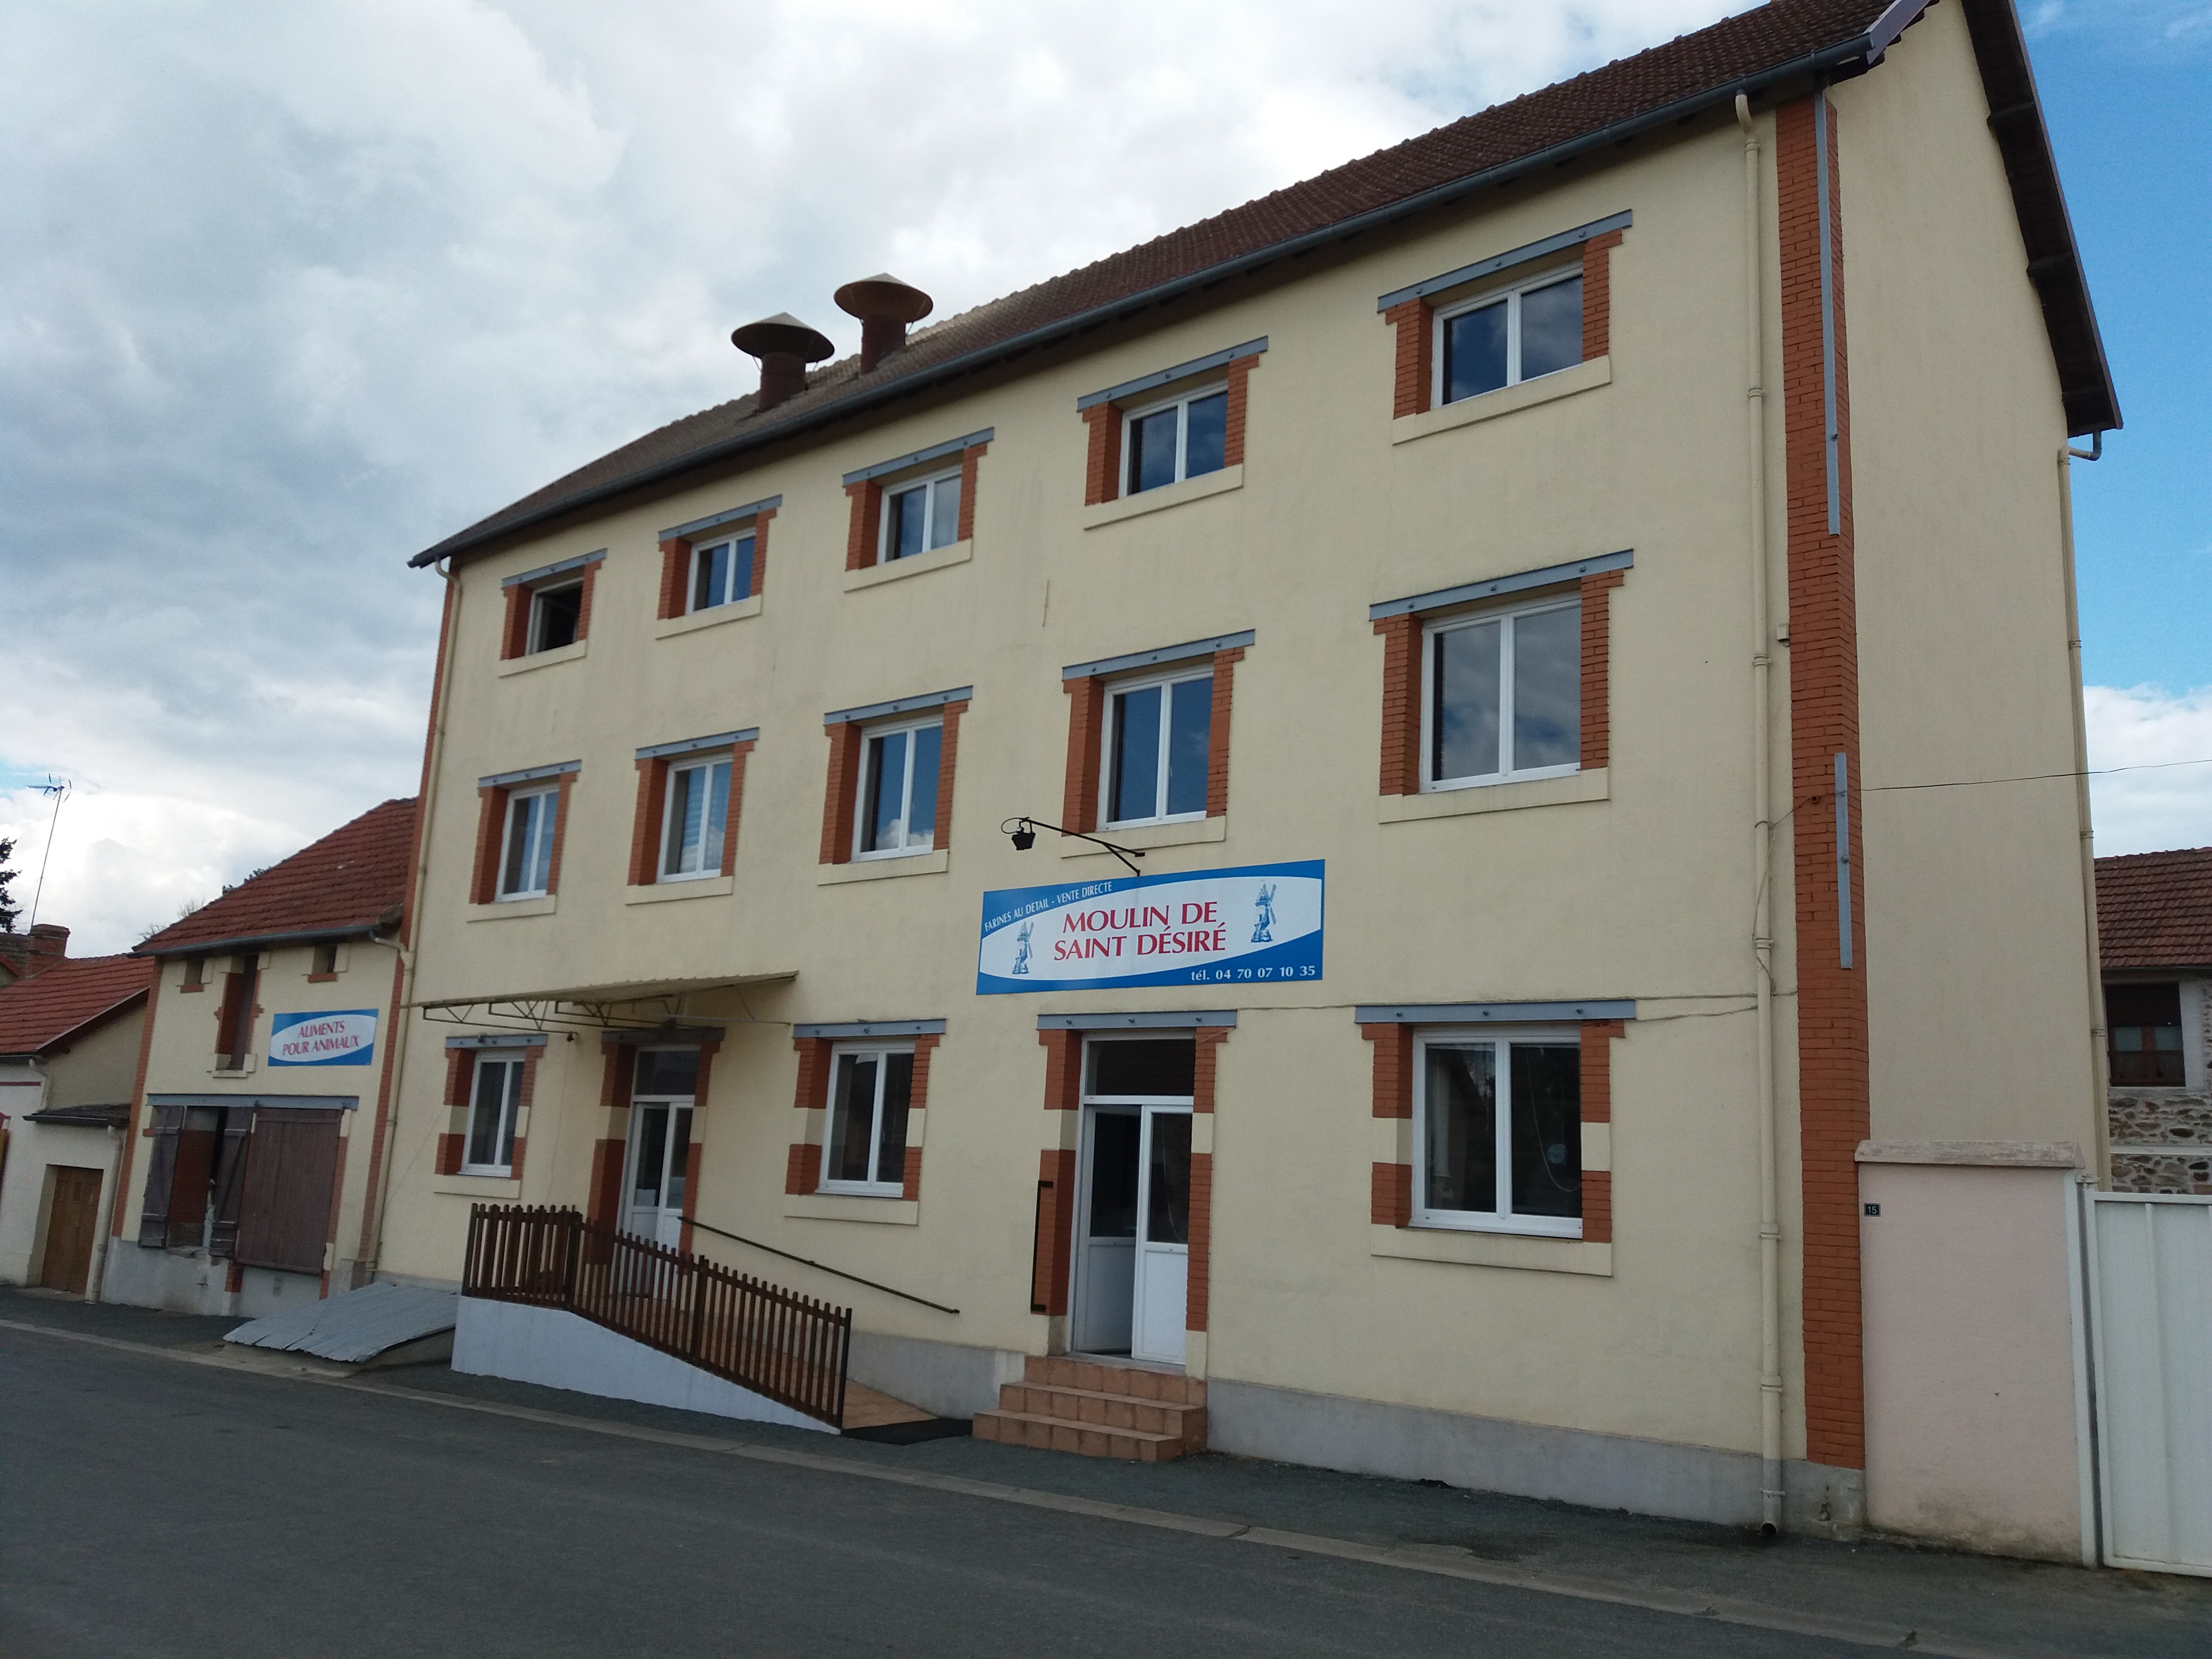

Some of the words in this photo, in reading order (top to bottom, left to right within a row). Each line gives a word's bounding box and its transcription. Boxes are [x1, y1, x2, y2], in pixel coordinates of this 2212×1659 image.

[984, 911, 1012, 932] FARINES
[1013, 907, 1023, 918] AU
[1026, 898, 1049, 915] DETAIL
[1057, 890, 1079, 904] VENTE
[1082, 881, 1112, 897] DIRECTE
[1063, 905, 1169, 933] MOULIN
[1182, 901, 1217, 924] DE
[1053, 936, 1127, 961] SAINT
[1137, 922, 1226, 955] DÉSIRÉ
[1191, 969, 1210, 981] tél.
[1215, 969, 1231, 980] 04
[1237, 968, 1252, 979] 70
[1257, 967, 1273, 978] 07
[1280, 966, 1294, 977] 10
[1299, 965, 1316, 976] 35
[297, 1020, 345, 1038] ALIMENTS
[282, 1041, 310, 1056] POUR
[312, 1035, 359, 1052] ANIMAUX
[1868, 1206, 1877, 1214] 15
